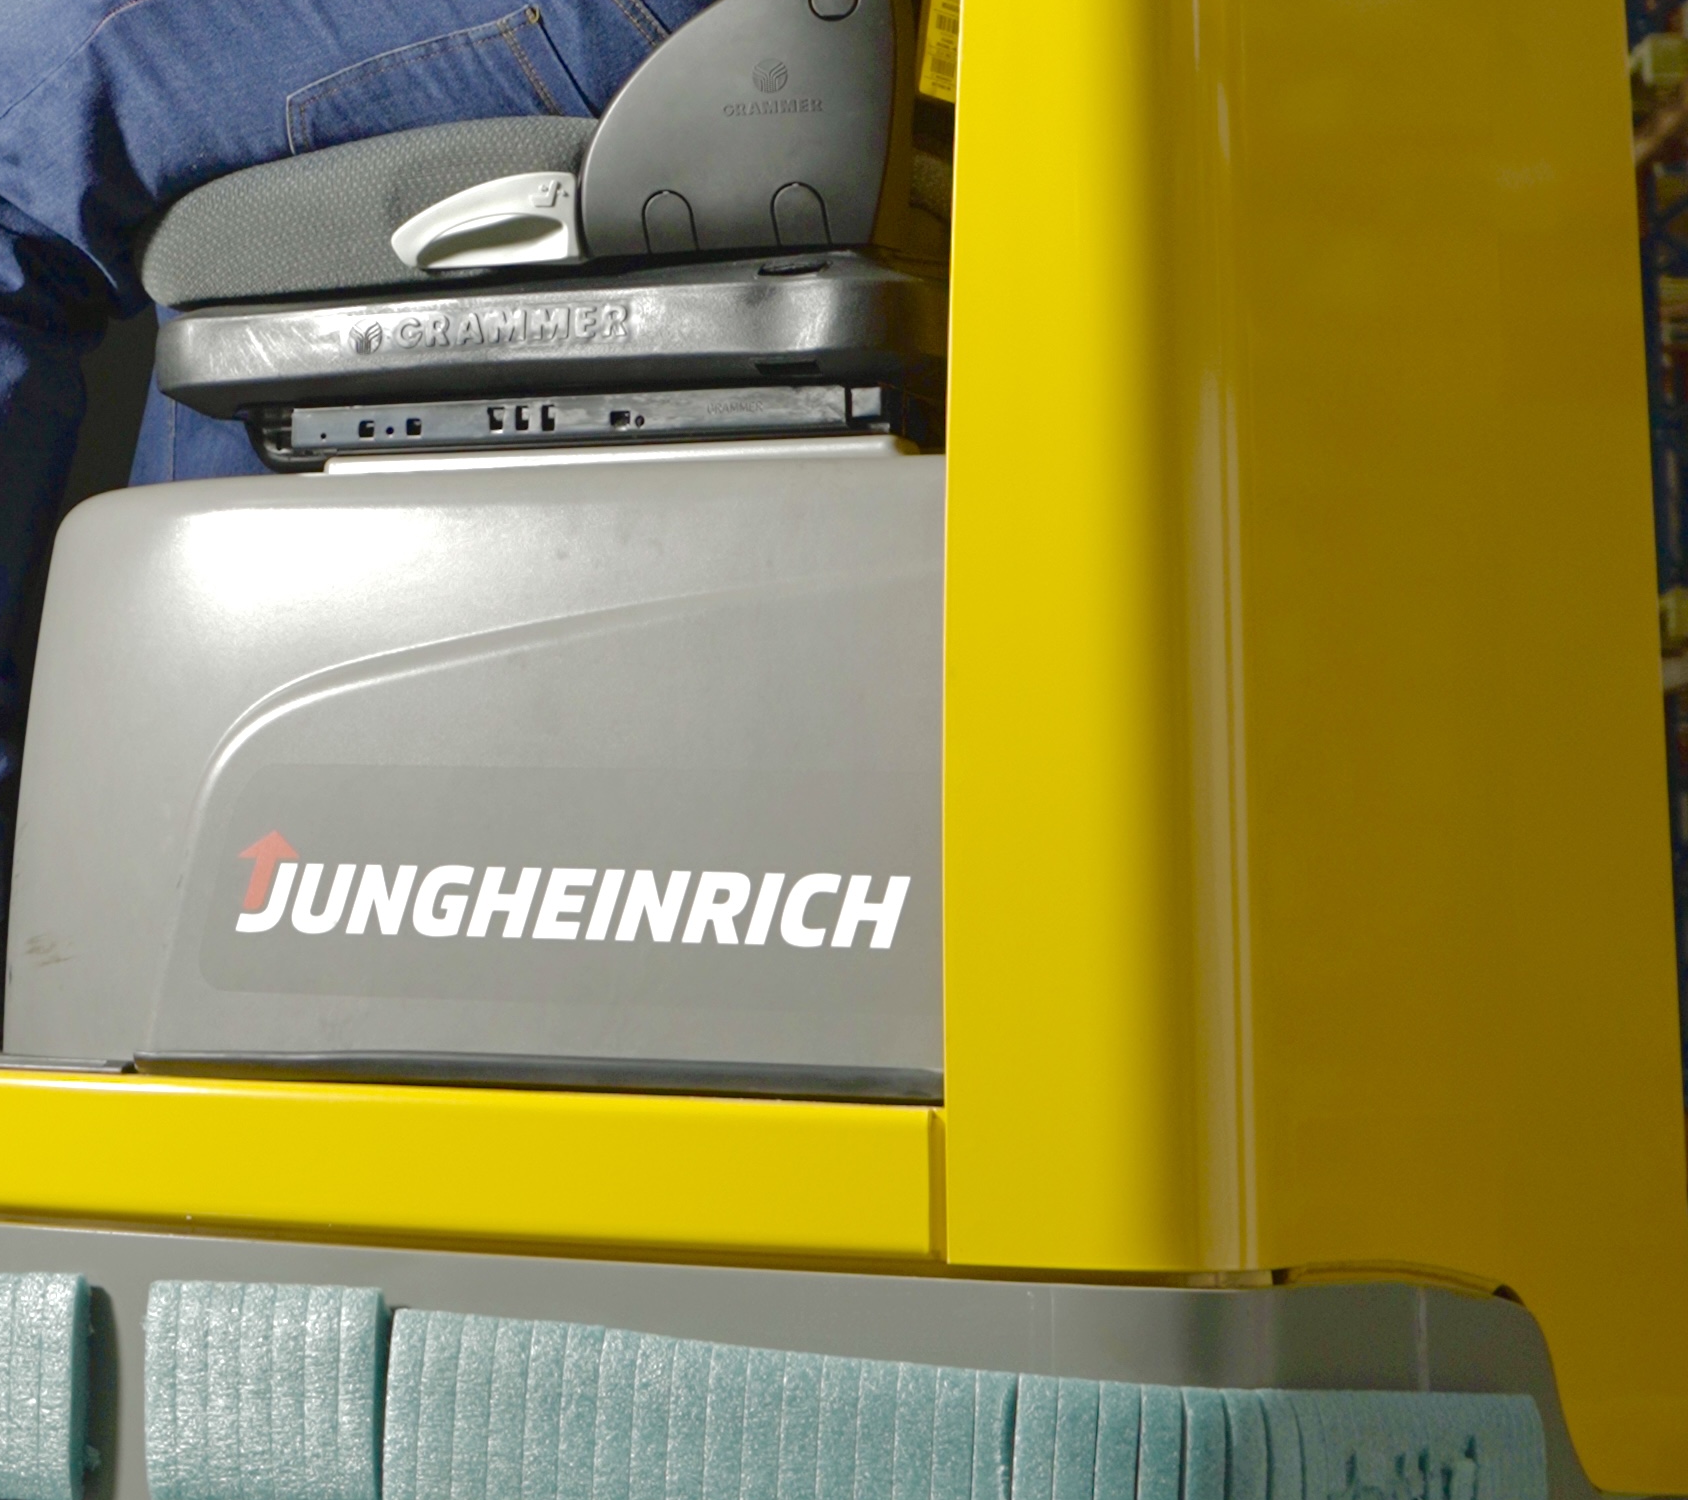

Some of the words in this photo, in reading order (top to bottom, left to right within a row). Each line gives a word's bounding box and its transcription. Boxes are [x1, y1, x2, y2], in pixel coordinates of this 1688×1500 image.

[723, 98, 823, 117] GRAMMER
[394, 304, 630, 349] GRAMMER
[707, 401, 764, 415] GRAMMER
[235, 862, 911, 949] JUNGHEINRICH
